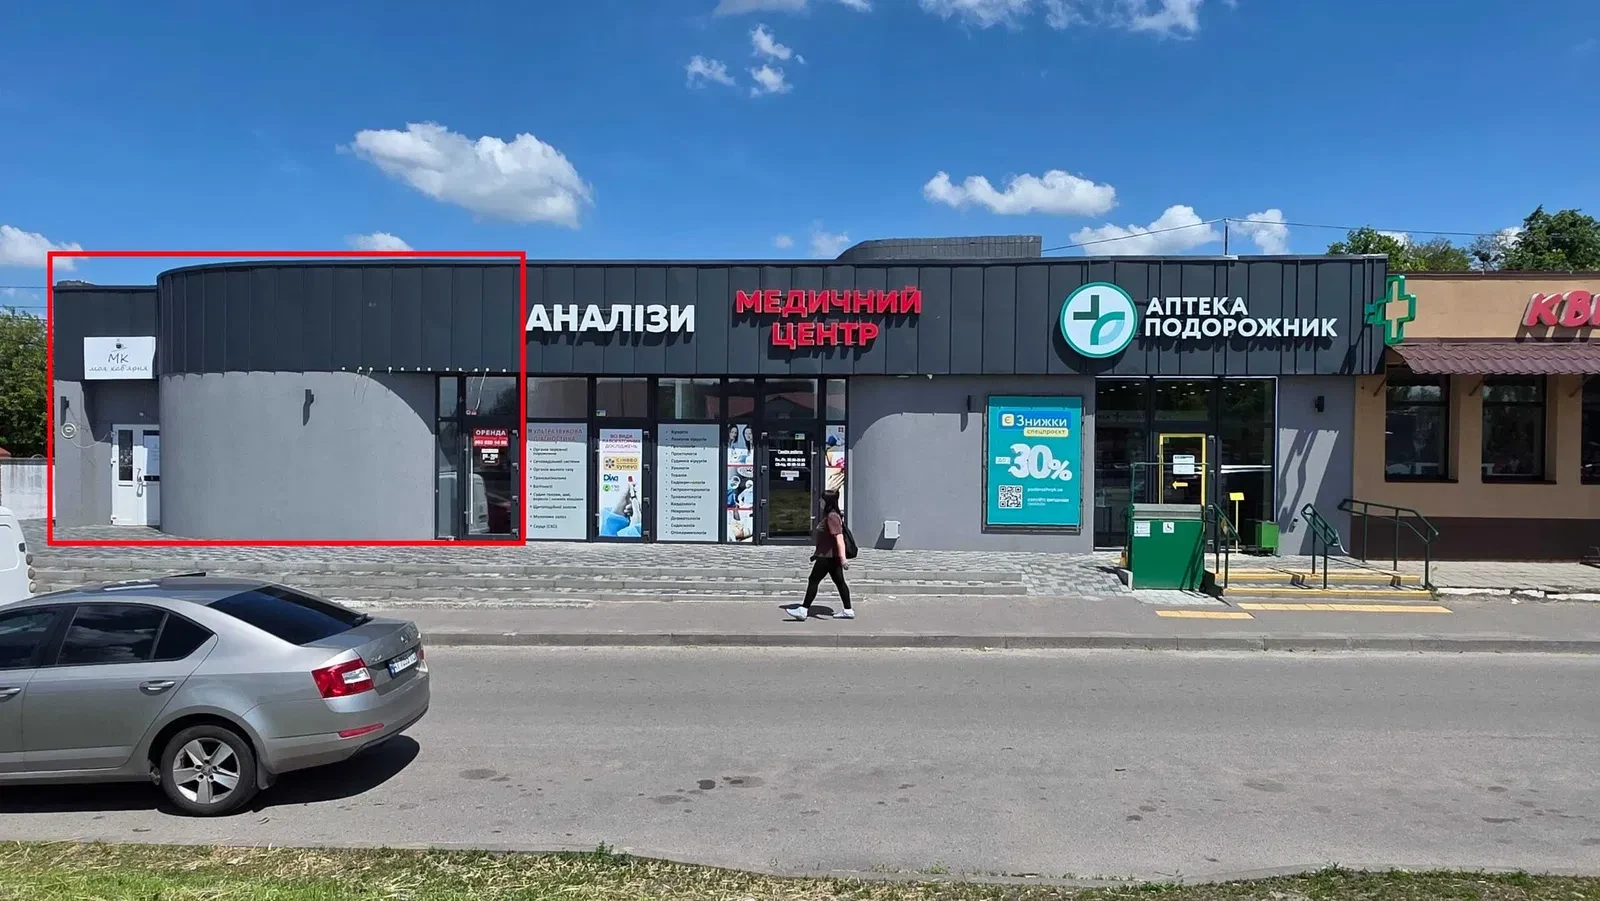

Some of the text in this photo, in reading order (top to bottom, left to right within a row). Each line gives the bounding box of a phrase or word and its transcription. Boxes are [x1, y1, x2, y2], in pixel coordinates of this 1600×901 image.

[736, 286, 922, 317] МЕДИЧНИЙ
[1145, 297, 1249, 316] АПТЕКА
[526, 303, 695, 333] АНАЛІЗИ
[1145, 318, 1338, 339] ПОДОРОЖНИК
[771, 322, 879, 349] ЦЕНТР
[1016, 415, 1067, 427] Знижки
[475, 429, 506, 437] ОРЕНДА
